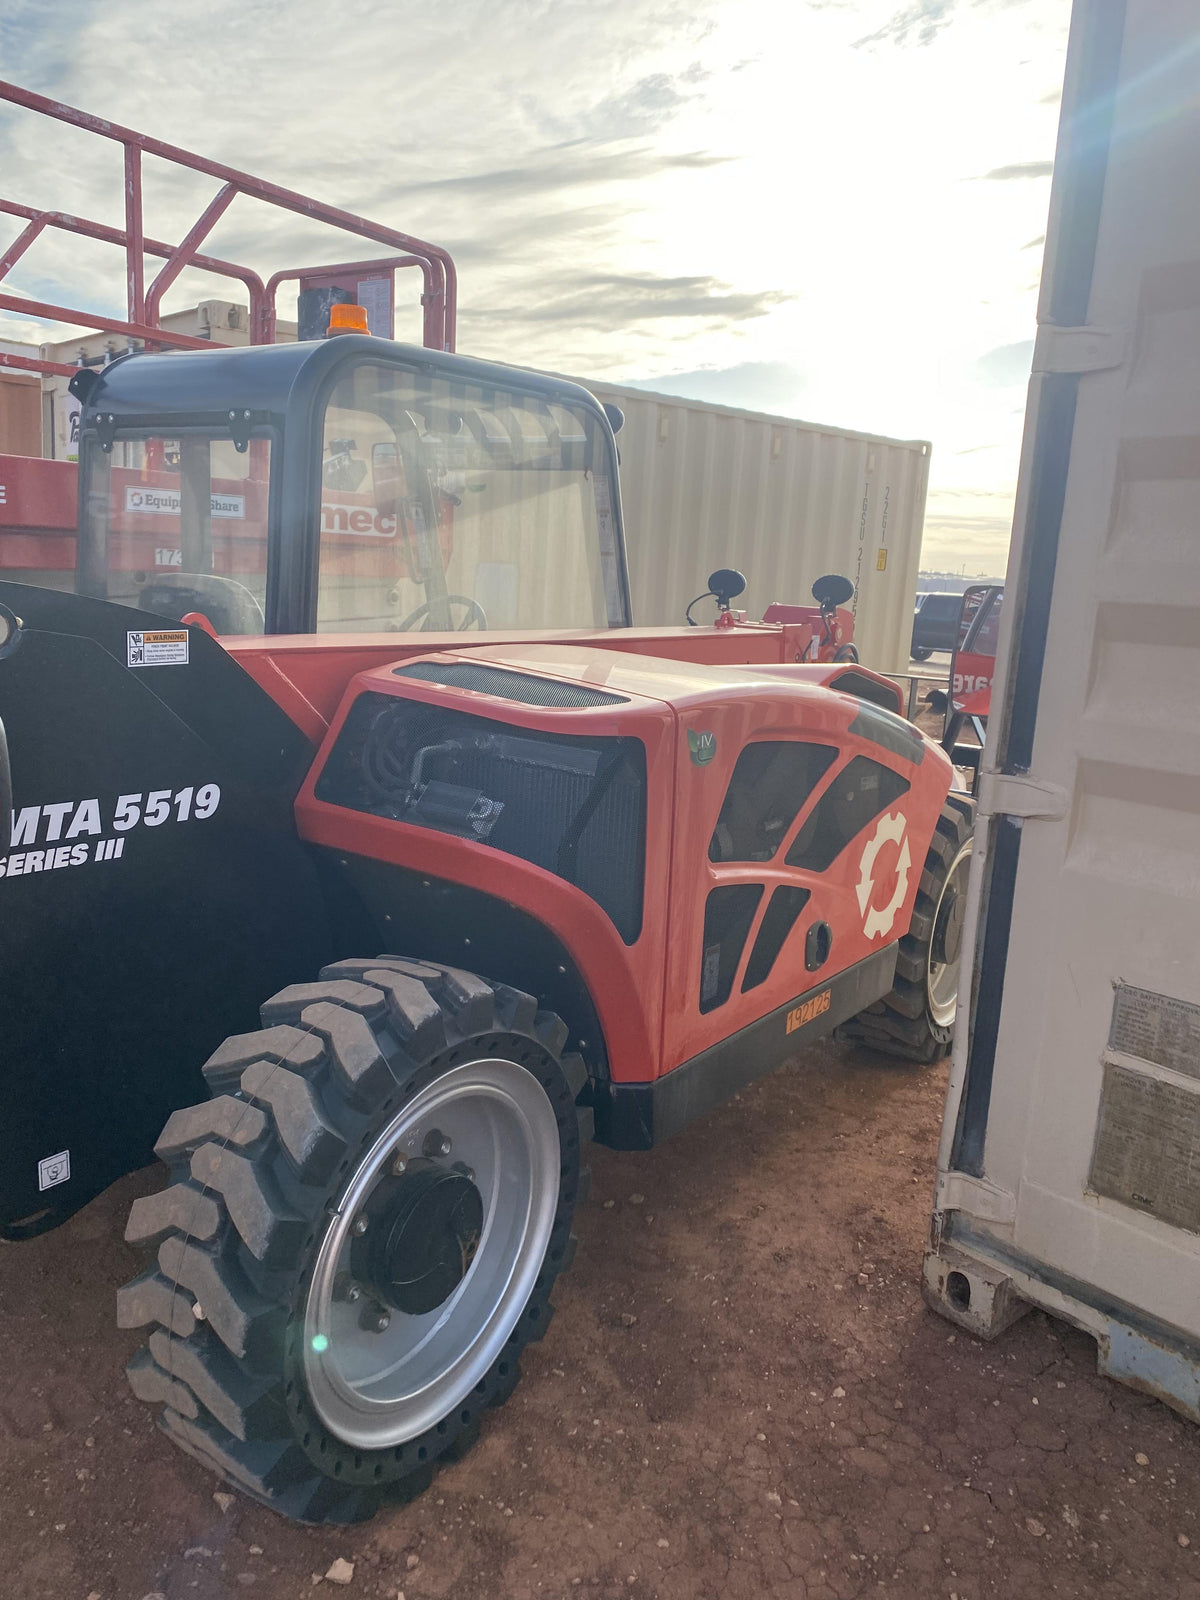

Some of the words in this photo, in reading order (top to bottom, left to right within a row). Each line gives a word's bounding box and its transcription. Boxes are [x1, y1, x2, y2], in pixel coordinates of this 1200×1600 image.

[152, 633, 185, 641] WARNING
[113, 783, 222, 832] 5519
[94, 838, 125, 862] III
[788, 990, 830, 1033] 192125
